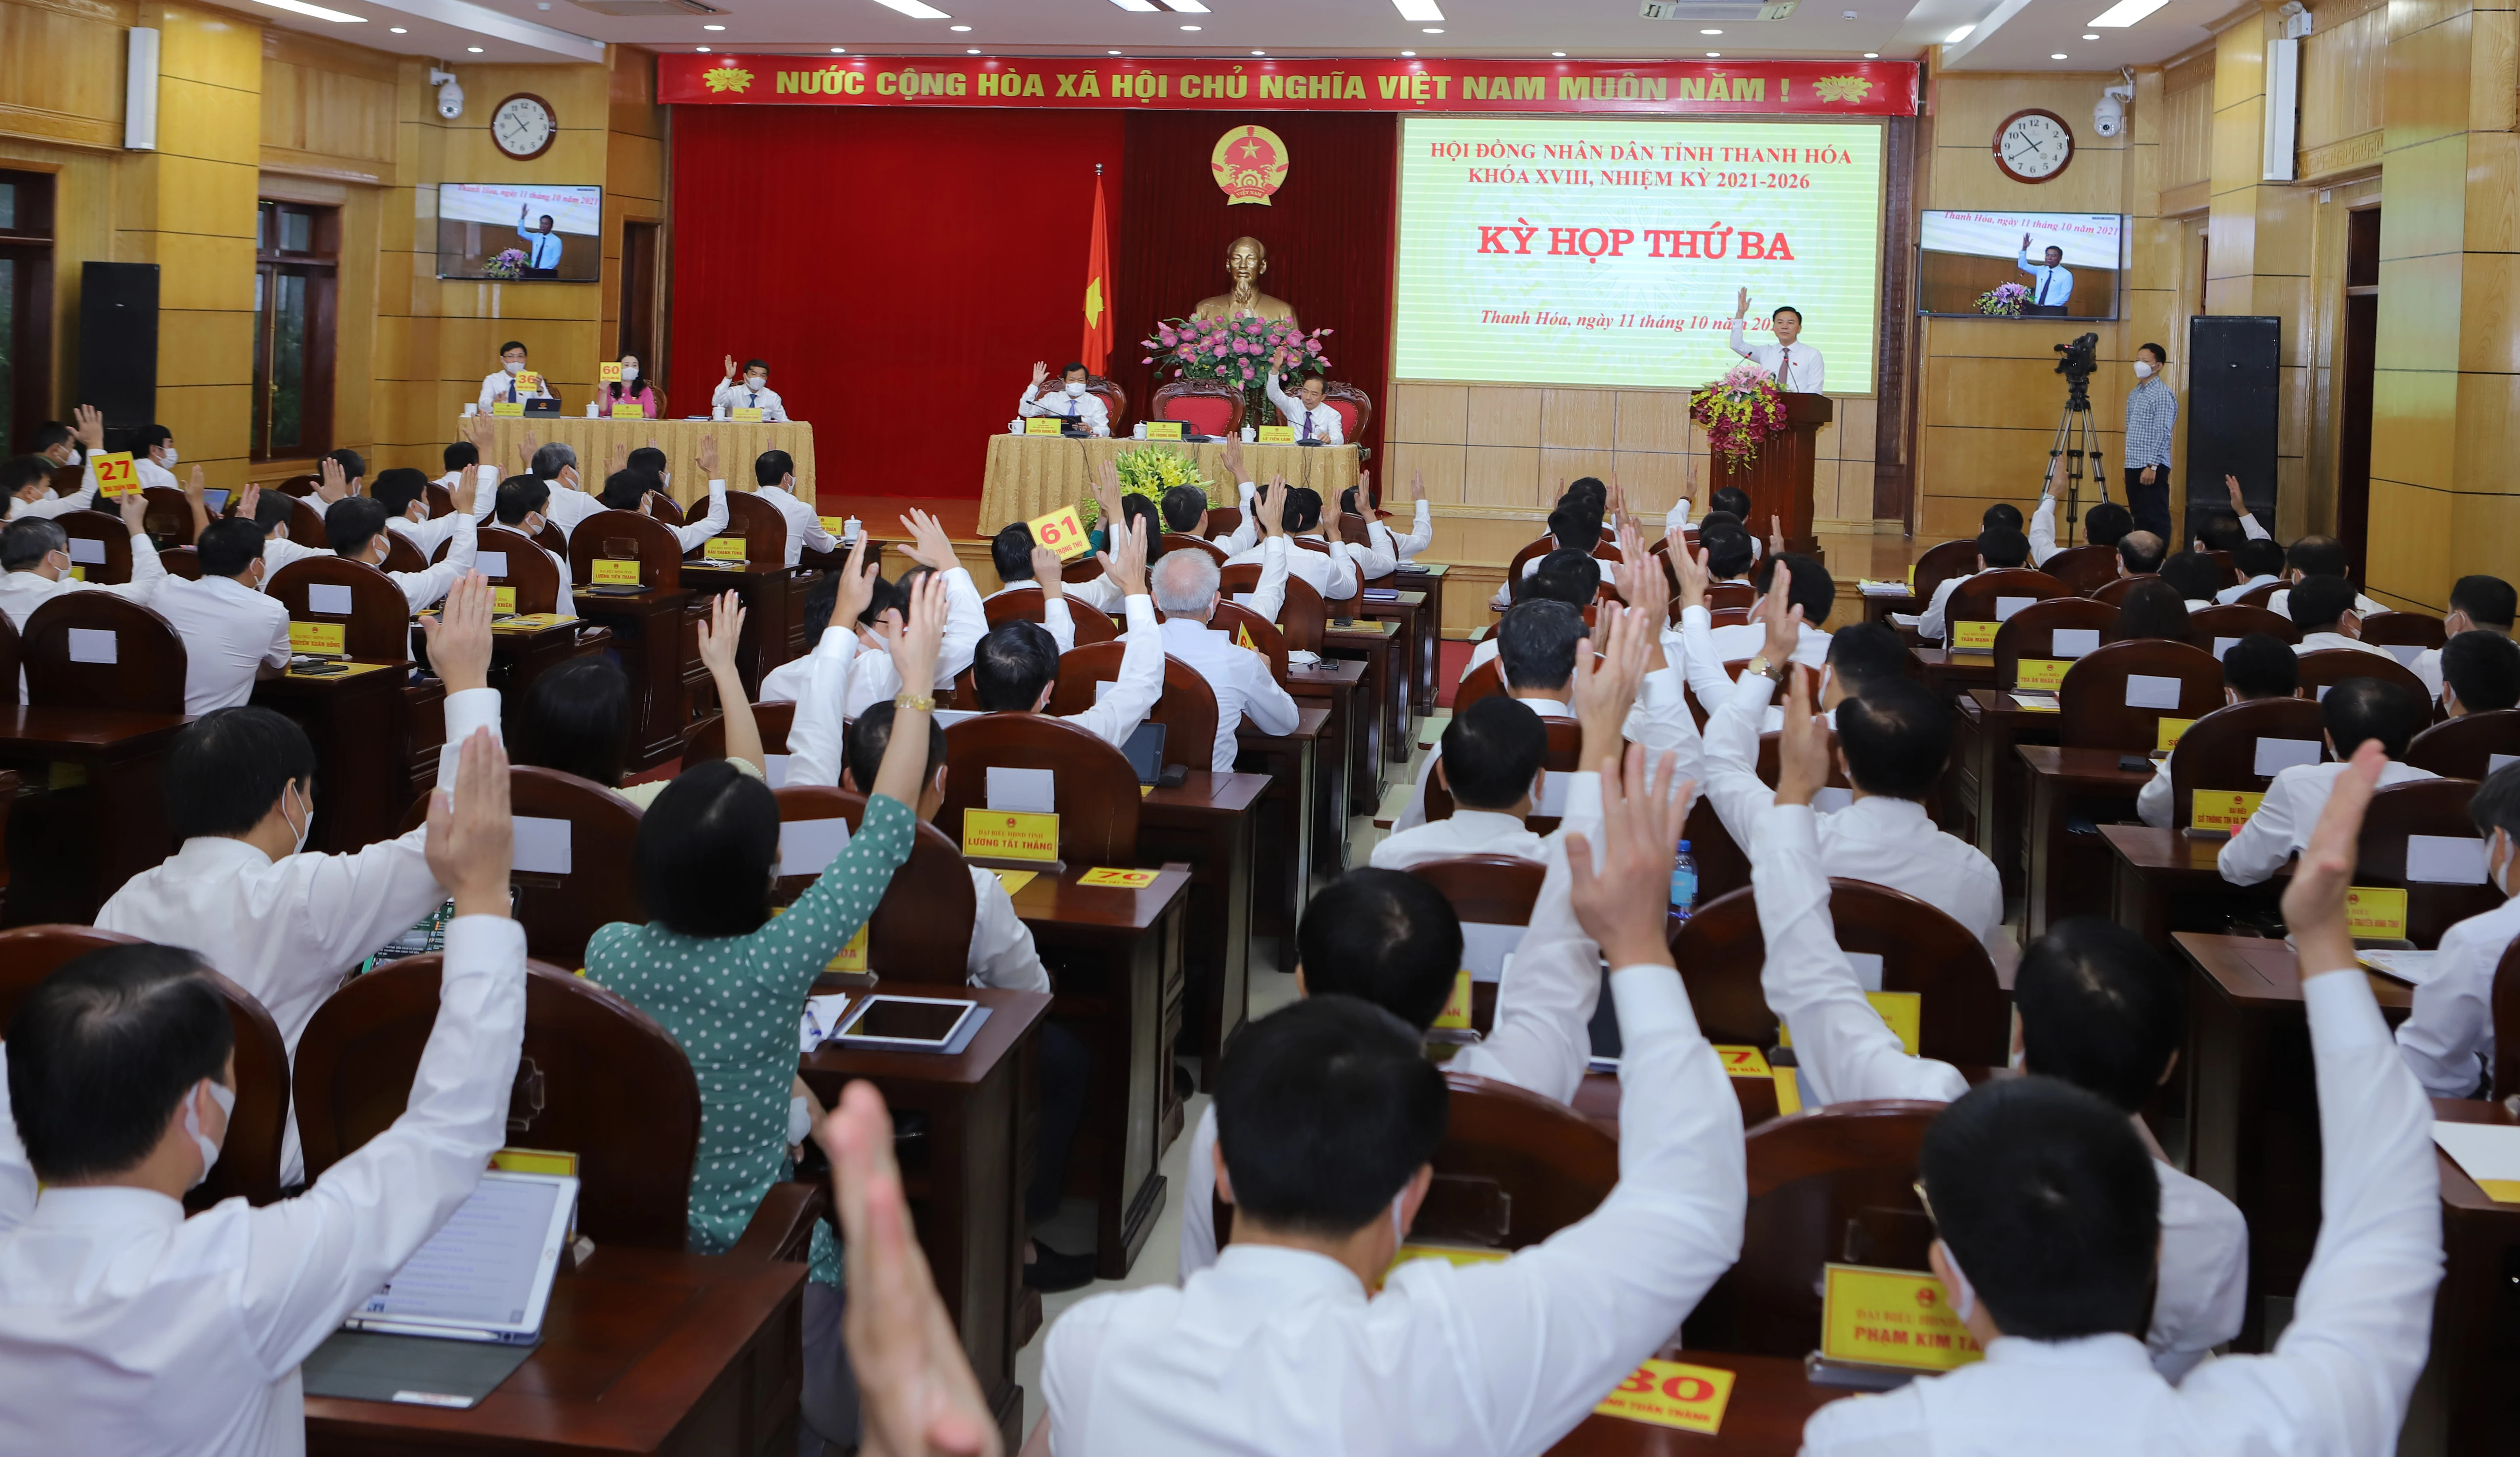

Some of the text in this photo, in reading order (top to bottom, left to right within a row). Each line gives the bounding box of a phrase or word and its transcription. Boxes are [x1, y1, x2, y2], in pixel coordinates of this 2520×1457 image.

[777, 65, 864, 94] NƯỚC
[876, 68, 966, 100] CỘNG
[978, 68, 1044, 96] HÒA
[1055, 70, 1100, 97] XÃ
[1112, 70, 1167, 103] HỘI
[1180, 65, 1247, 98] CHỦ
[1260, 71, 1366, 99] NGHĨA
[1378, 71, 1451, 104] VIỆT
[1463, 76, 1545, 100] NAM
[1558, 72, 1666, 101] MUÔN
[1680, 72, 1765, 102] NĂM
[1431, 139, 1852, 164] HỘI ĐỒNG NHÂN DÂN TỈNH THANH HÓA
[1468, 164, 1810, 190] KHÓA XVIII, NHIỆM KỲ 2021-2026
[581, 197, 598, 205] 2021
[1944, 211, 1972, 221] Thanh
[1997, 217, 2018, 227] ngày
[2033, 220, 2058, 231] tháng
[2074, 224, 2094, 233] năm
[2096, 226, 2118, 236] 2021
[1478, 217, 1794, 264] KỲ HỌP THỨ BA
[1481, 310, 1531, 325] Thanh
[1534, 311, 1571, 329] Hóa,
[1576, 312, 1613, 331] ngày
[1618, 313, 1634, 328] 11
[1640, 314, 1686, 332] tháng
[1690, 315, 1708, 330] 10
[1751, 317, 1774, 331] 20
[519, 375, 535, 384] 36
[603, 366, 620, 374] 60
[99, 460, 130, 481] 27
[1040, 516, 1077, 544] 61
[968, 838, 999, 847] LƯƠNG
[1098, 871, 1149, 881] 70
[1718, 1051, 1752, 1064] 7
[1854, 1325, 1951, 1349] PHẠM KIM
